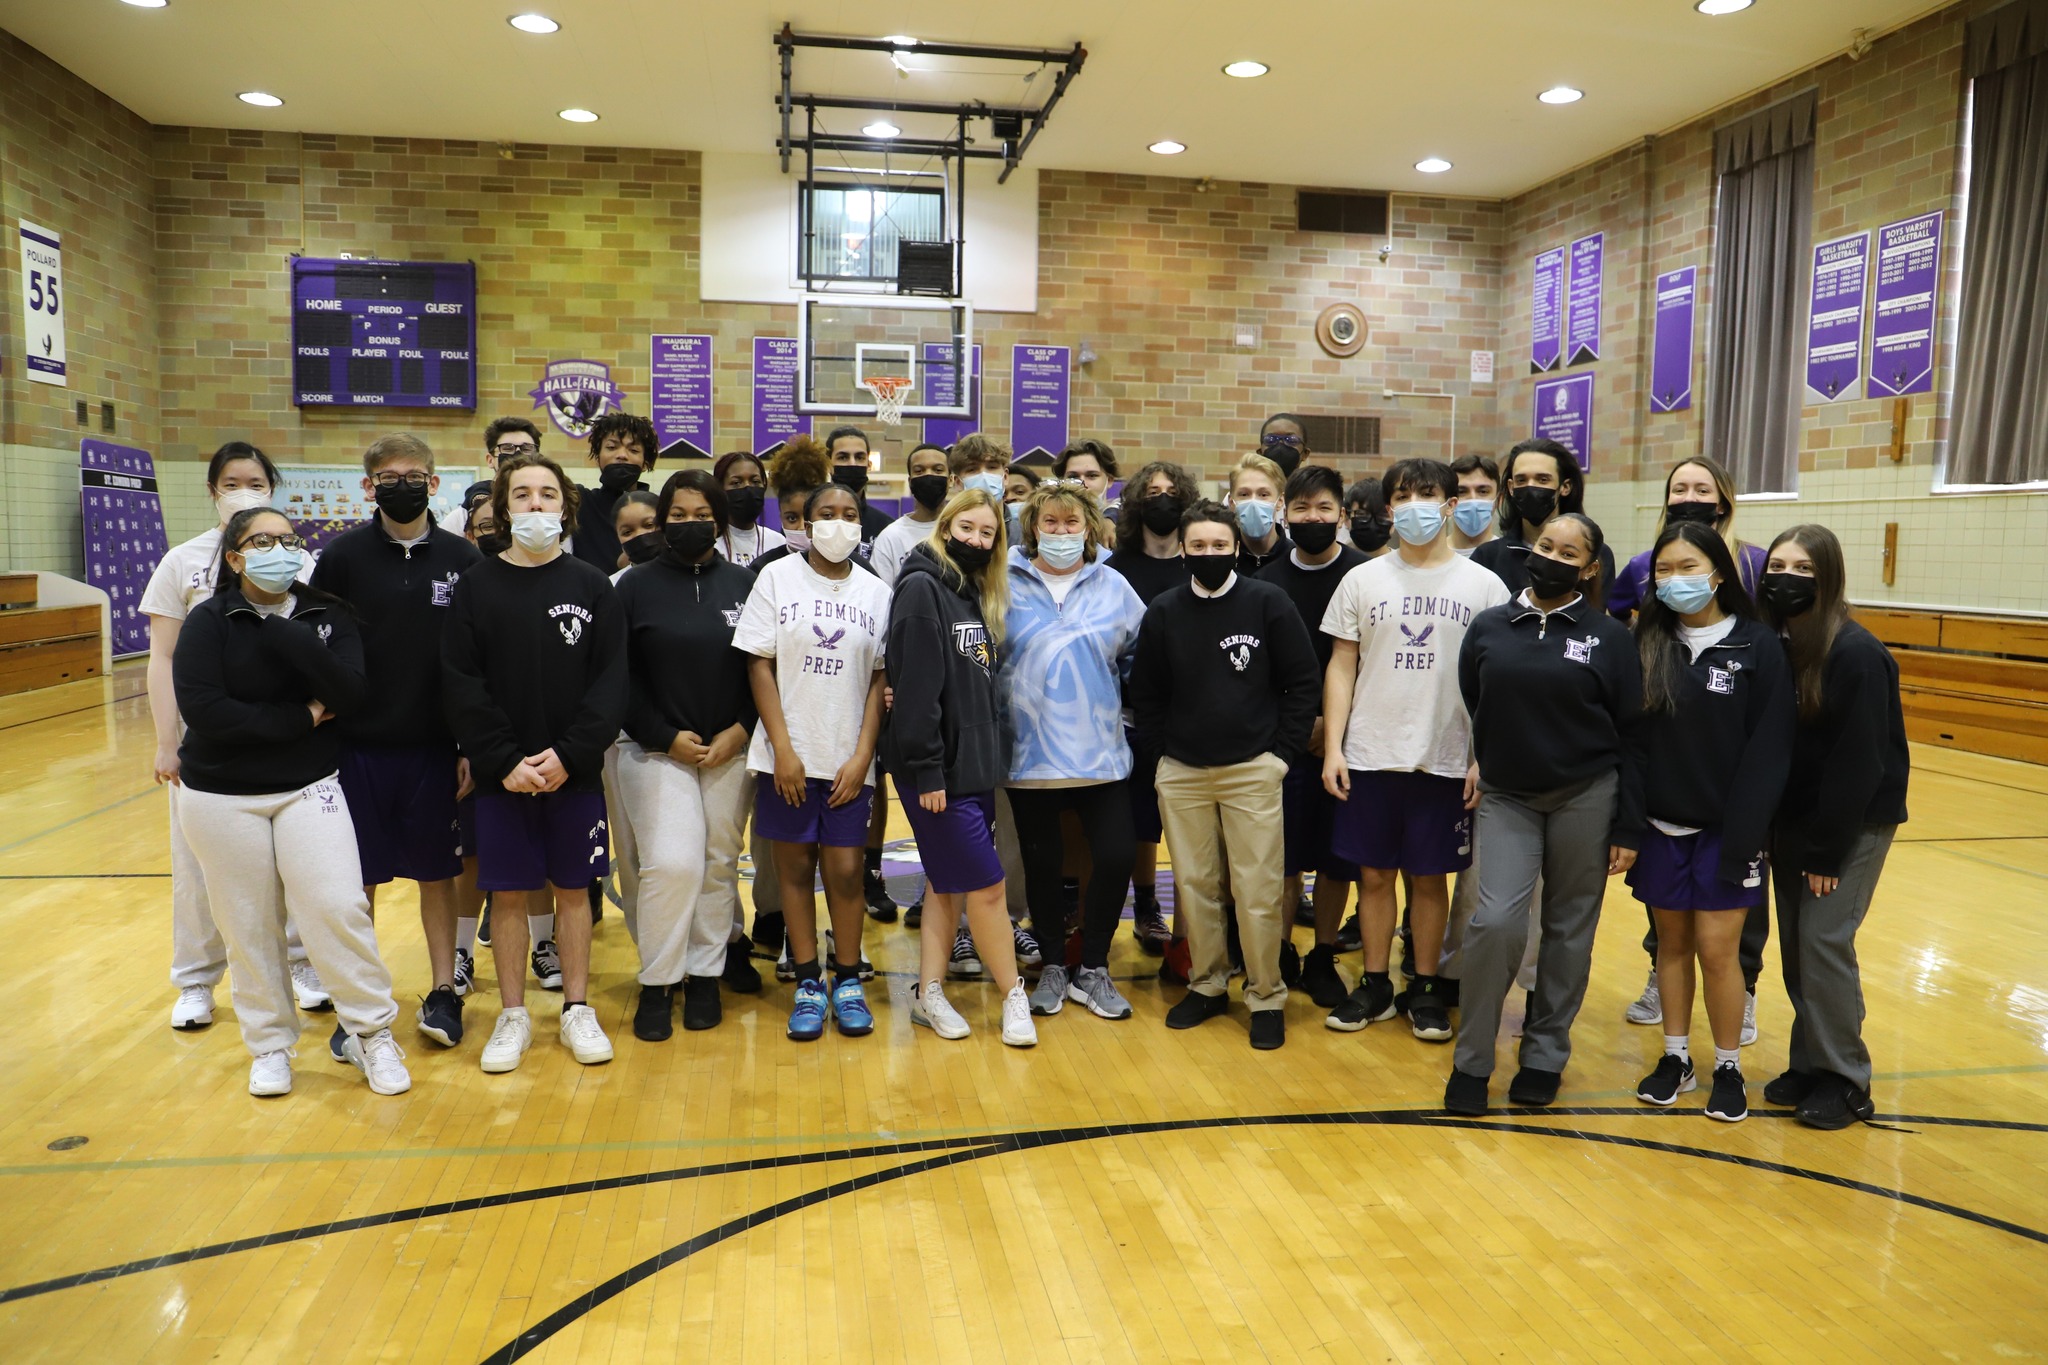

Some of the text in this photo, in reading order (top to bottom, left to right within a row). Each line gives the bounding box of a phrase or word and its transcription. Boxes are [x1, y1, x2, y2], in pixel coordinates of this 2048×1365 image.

[1886, 218, 1934, 239] BOYS VARSITY
[1888, 229, 1929, 247] BASKETBALL
[1820, 238, 1863, 256] GIRLS VARSITY
[27, 249, 57, 268] POLLARD
[1822, 248, 1858, 263] BASKETBALL
[30, 270, 59, 315] 55
[306, 300, 342, 311] HOME
[368, 306, 403, 315] PERIOD
[425, 303, 463, 314] GUEST
[364, 321, 405, 331] P P
[368, 336, 401, 345] BONUS
[298, 347, 329, 356] FOULS
[352, 348, 387, 357] PLAYER
[399, 350, 424, 359] FOUL
[441, 351, 469, 360] FOULS
[544, 377, 573, 394] HALL
[583, 377, 611, 394] FAME
[302, 394, 334, 403] SCORE
[353, 395, 384, 403] MATCH
[430, 396, 462, 405] SCORE
[432, 580, 450, 607] E
[548, 603, 593, 623] SENIORS
[780, 600, 875, 637] ST. EDMUND
[1370, 596, 1471, 627] ST. EDMUND
[1219, 634, 1260, 650] SENIORS
[1564, 638, 1588, 664] E
[803, 655, 844, 676] PREP
[1394, 653, 1435, 669] PREP
[1707, 666, 1731, 694] E
[321, 805, 339, 814] PREP
